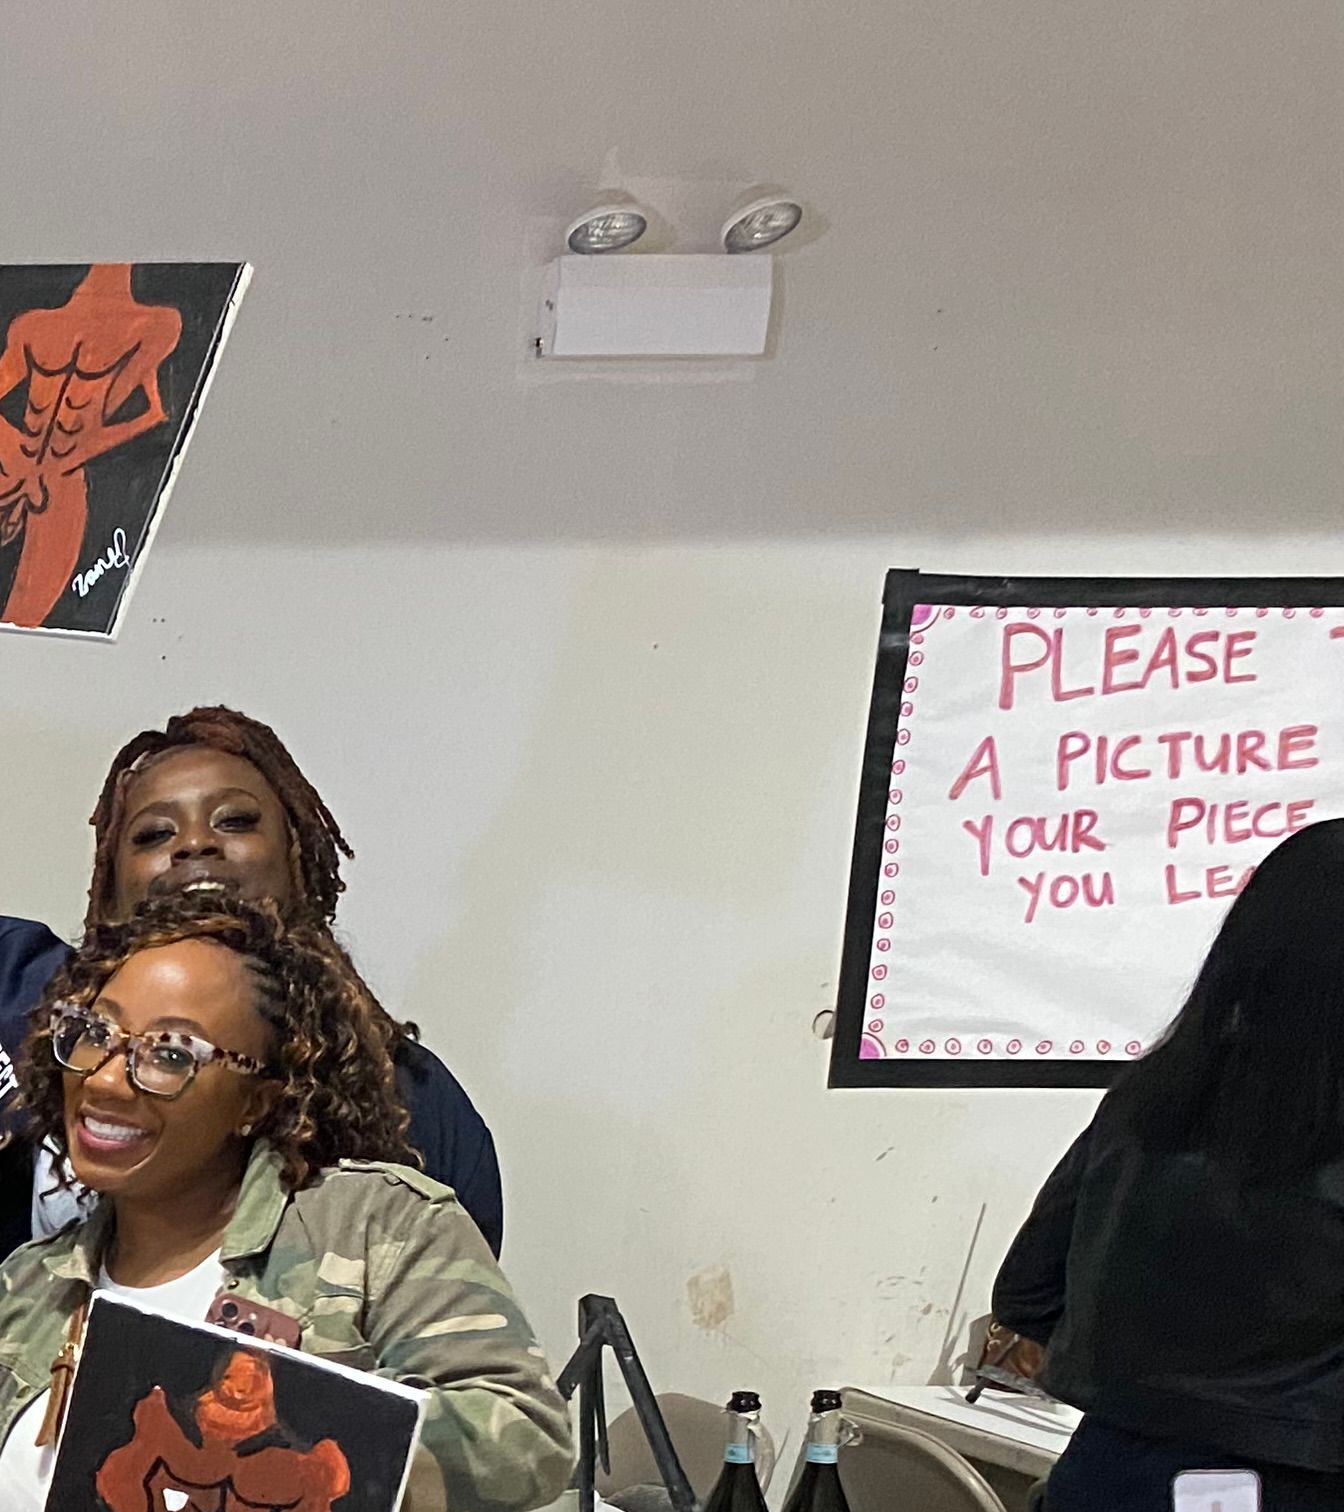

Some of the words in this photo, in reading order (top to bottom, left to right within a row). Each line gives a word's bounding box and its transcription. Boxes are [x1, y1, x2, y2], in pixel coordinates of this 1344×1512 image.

[999, 623, 1257, 710] PLEASE
[949, 736, 1001, 800] A
[1056, 725, 1319, 791] PICTURE
[962, 809, 1107, 876] YOUR
[1168, 797, 1315, 849] PIECE
[1018, 871, 1115, 923] YOU
